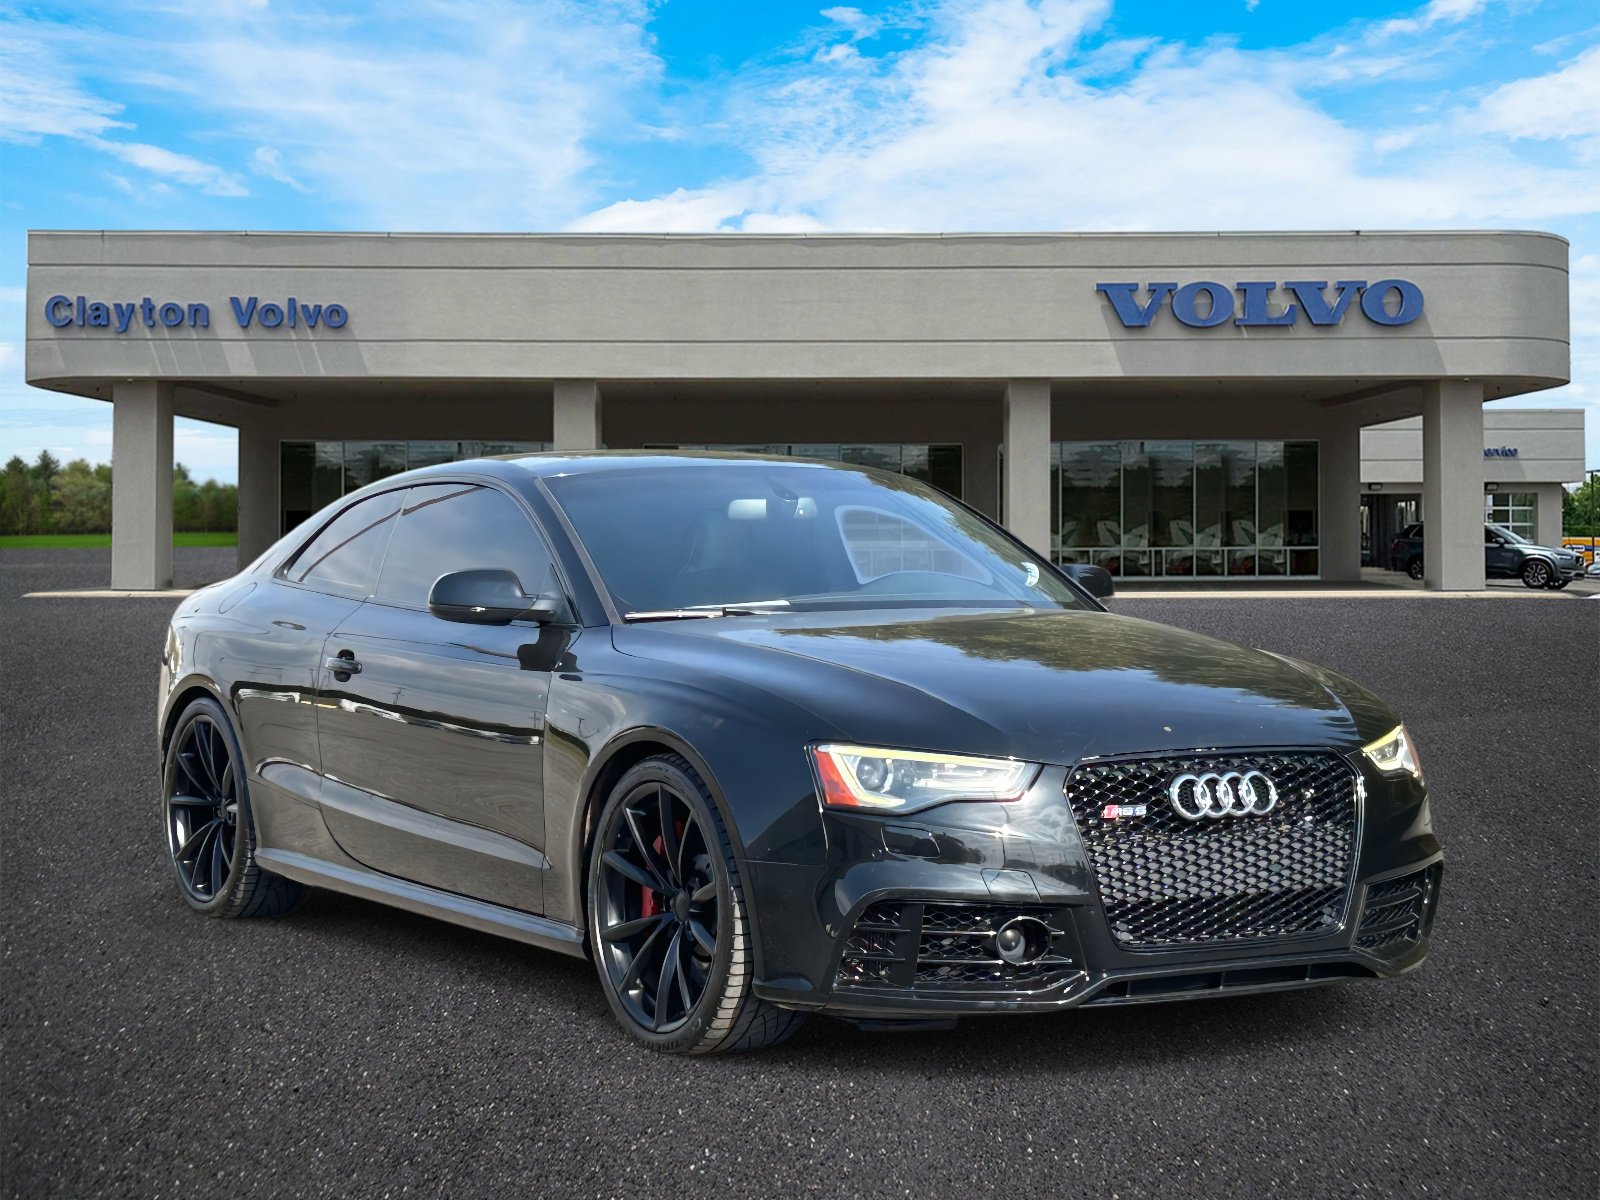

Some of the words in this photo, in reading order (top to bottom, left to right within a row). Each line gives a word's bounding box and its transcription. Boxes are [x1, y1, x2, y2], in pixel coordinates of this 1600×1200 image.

[45, 295, 209, 332] Clayton
[230, 296, 349, 329] Volvo
[1095, 279, 1424, 328] VOLVO
